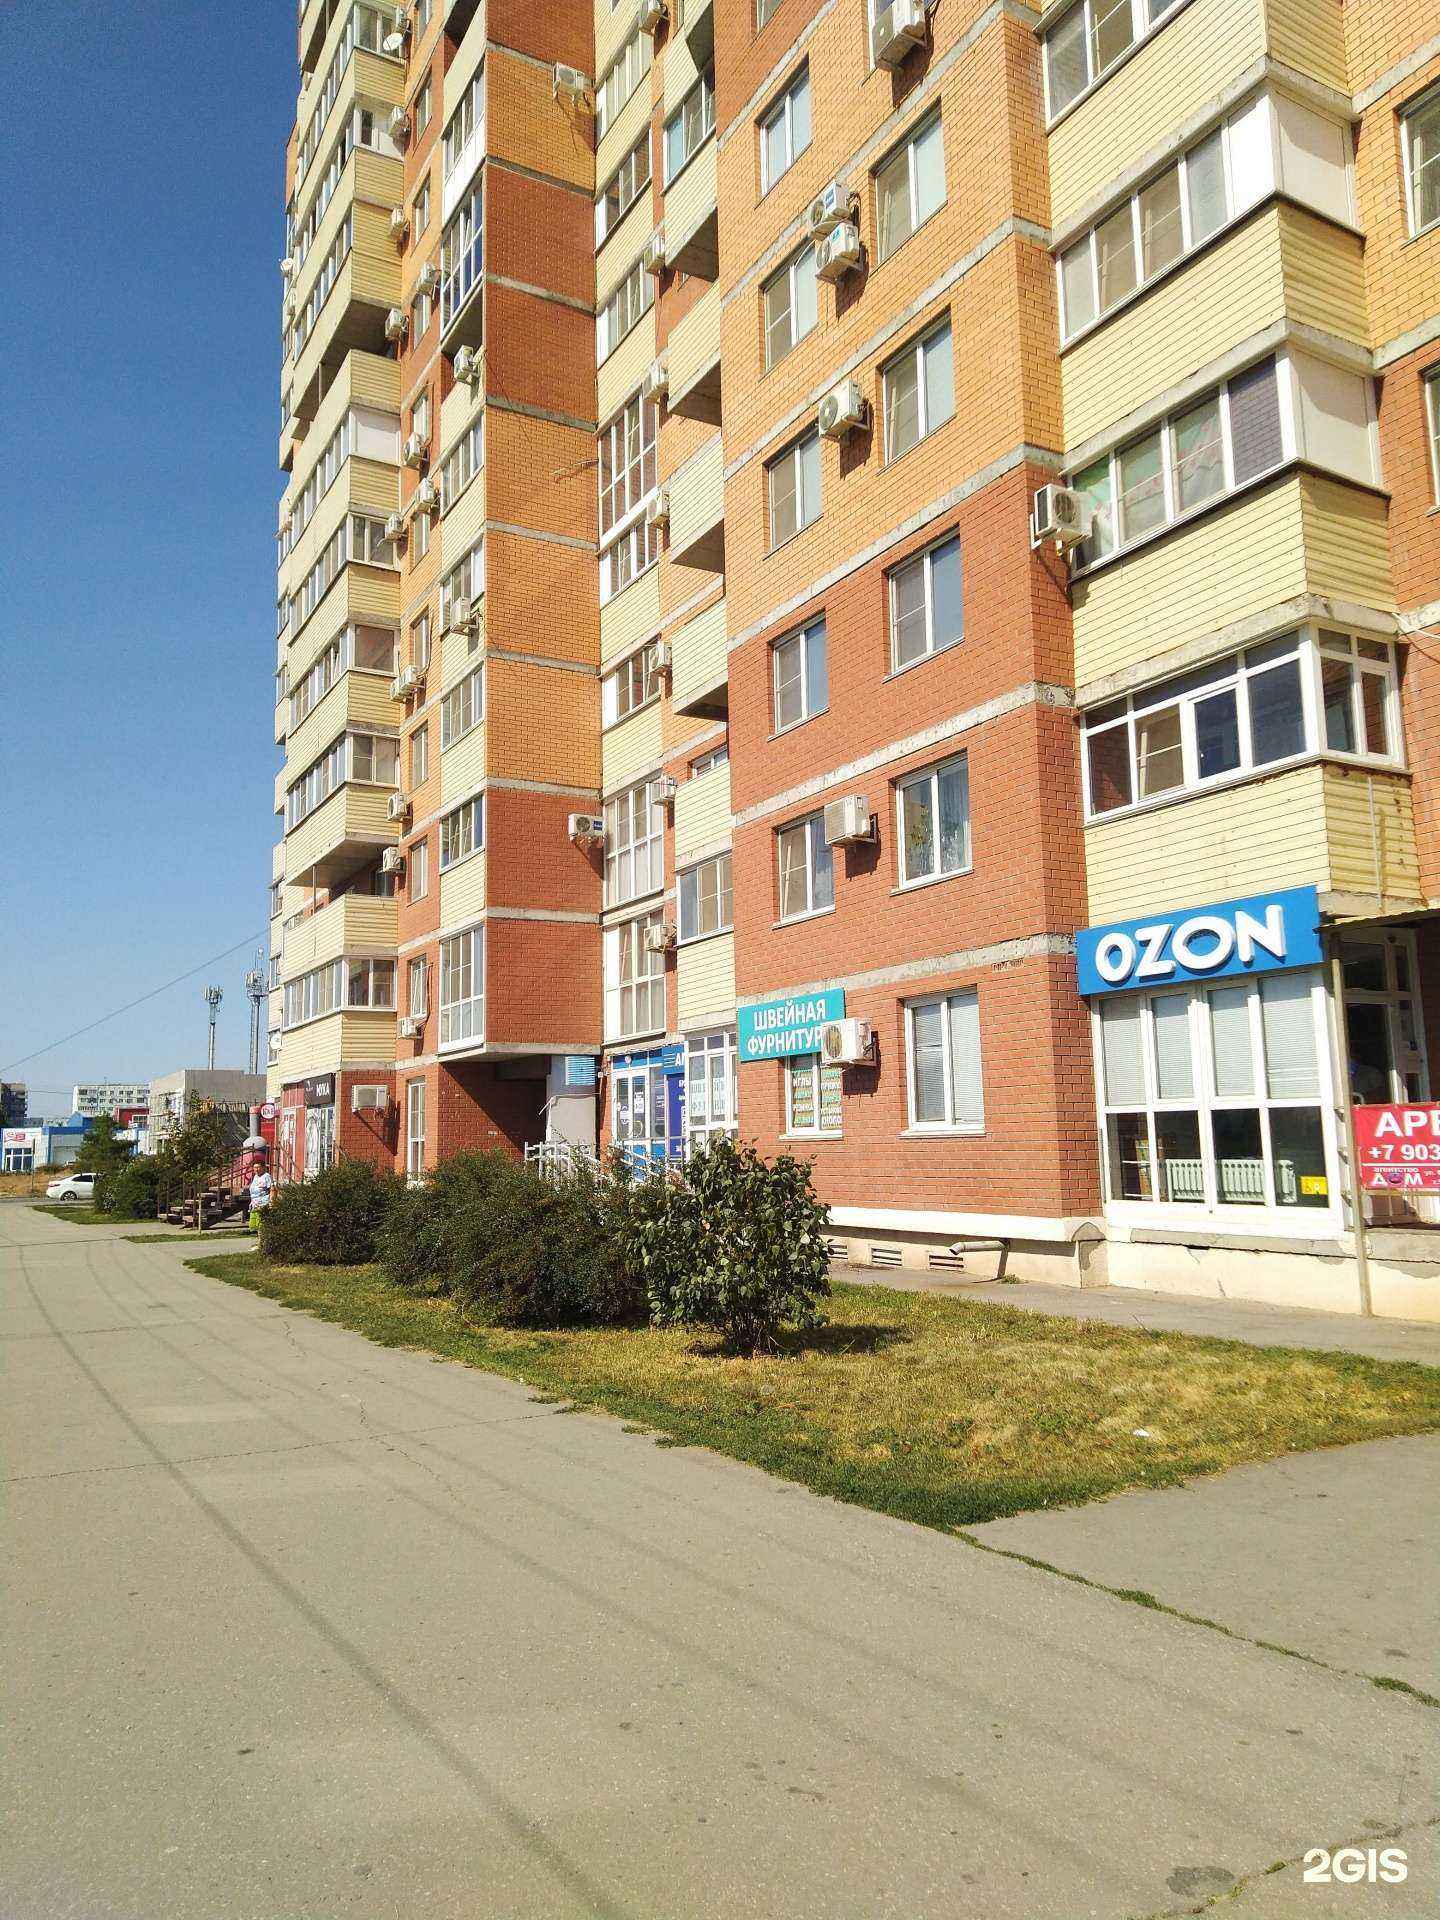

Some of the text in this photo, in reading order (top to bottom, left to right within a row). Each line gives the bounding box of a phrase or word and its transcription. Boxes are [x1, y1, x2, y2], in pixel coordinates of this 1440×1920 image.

[1095, 904, 1288, 983] OZON
[753, 999, 827, 1031] ШВЕЙНАЯ
[747, 1026, 823, 1056] ФУРНИТУР
[1368, 1143, 1440, 1161] +7 903
